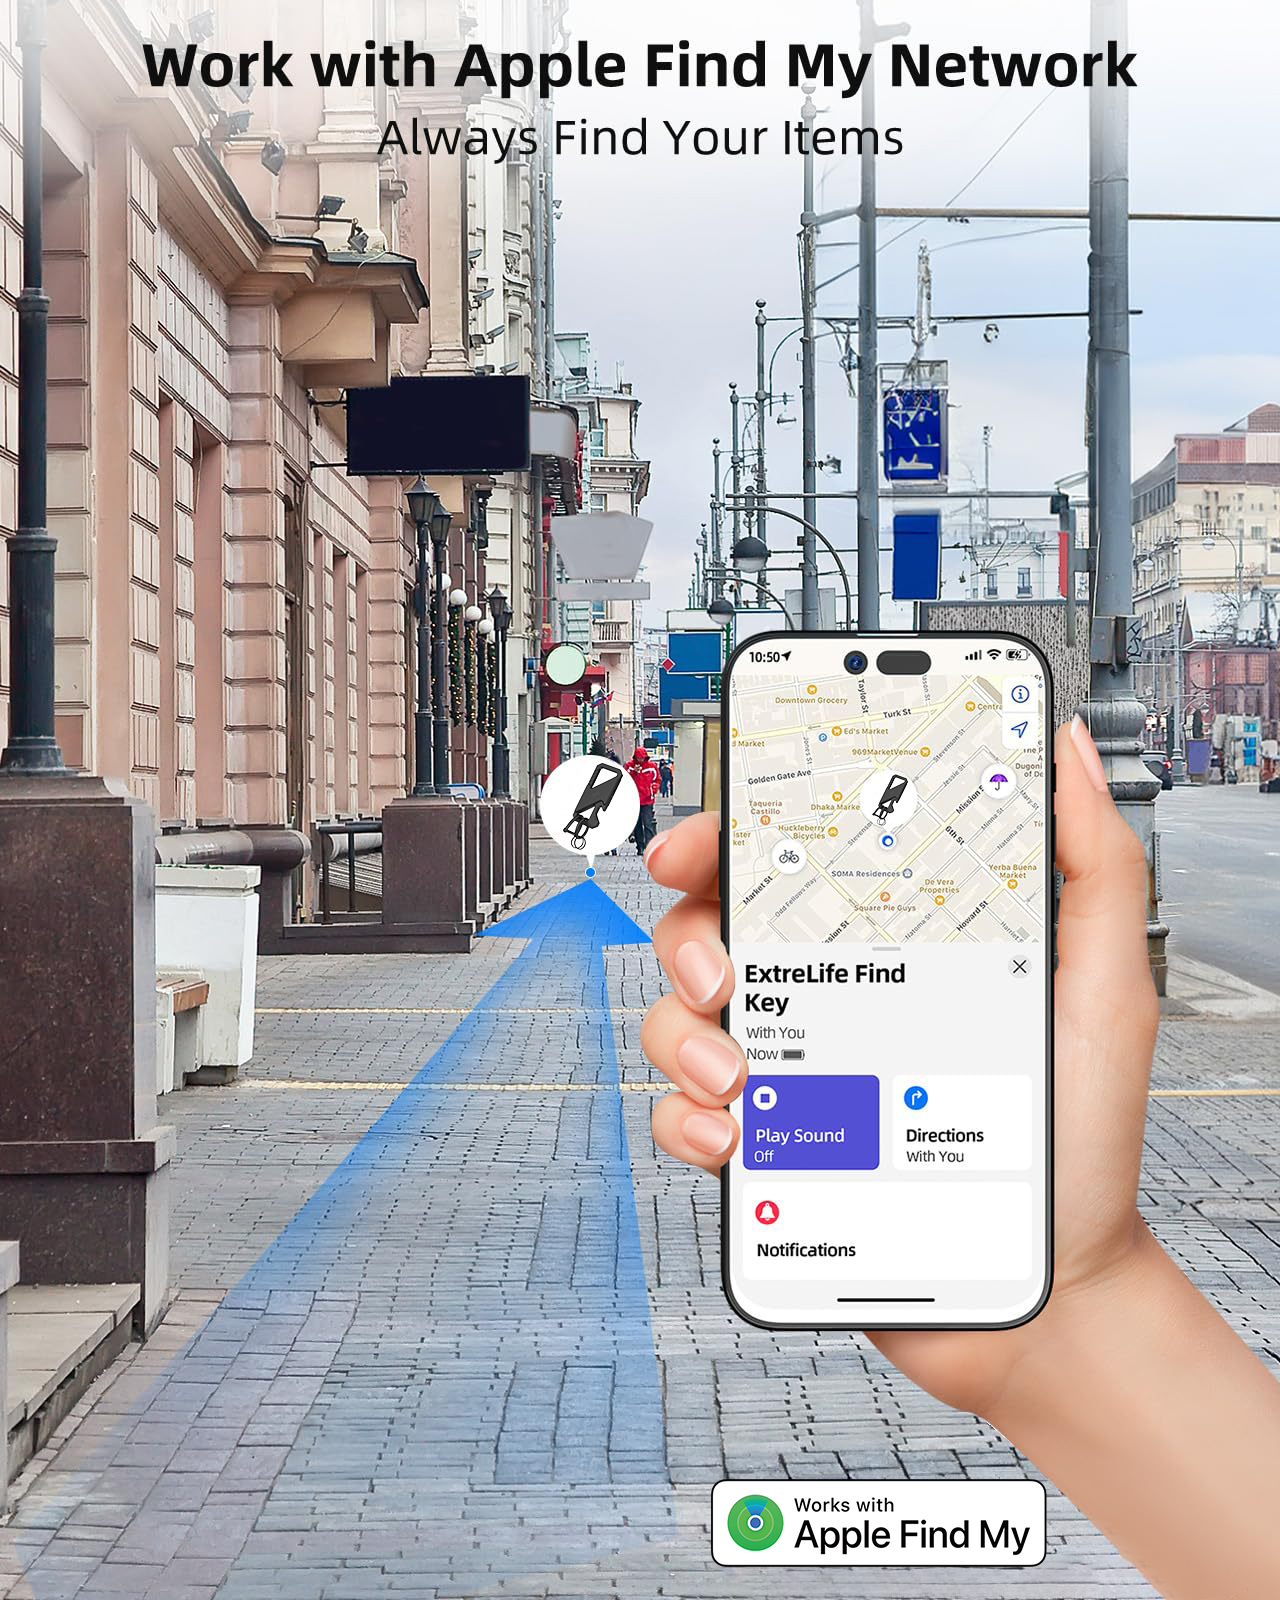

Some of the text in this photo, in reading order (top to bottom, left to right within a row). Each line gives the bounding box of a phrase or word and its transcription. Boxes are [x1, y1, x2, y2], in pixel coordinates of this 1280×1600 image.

[749, 651, 780, 663] 10:50
[817, 697, 848, 705] Grocery
[858, 679, 869, 713] Taylor St
[883, 708, 912, 719] Turk St
[844, 727, 889, 735] Ed's Market
[803, 736, 813, 765] Jones St
[852, 748, 918, 756] 969MarketVenue
[933, 728, 966, 763] Stevenson St
[748, 769, 812, 785] Golden Gate Ave
[943, 764, 966, 787] Jessie St
[749, 800, 783, 808] Taqueria
[811, 803, 835, 811] Dhaka
[955, 790, 981, 815] Mission
[1031, 802, 1040, 811] St
[981, 807, 1005, 831] Minna St
[945, 825, 965, 846] 6th St
[997, 823, 1025, 851] Natoma St
[742, 875, 773, 906] Market St
[774, 877, 817, 918] Odd Fellows Way
[854, 904, 881, 912] Square
[896, 904, 917, 912] Guys
[924, 913, 933, 921] St
[956, 900, 989, 932] Howard St
[840, 920, 850, 930] St
[745, 963, 906, 984] ExtreLife Find
[745, 993, 789, 1016] Key
[746, 1026, 805, 1039] With You
[746, 1048, 779, 1061] Now
[756, 1128, 845, 1146] Play Sound
[906, 1128, 984, 1143] Directions
[754, 1150, 774, 1162] Off
[906, 1150, 964, 1162] With You
[757, 1243, 856, 1258] Notifications
